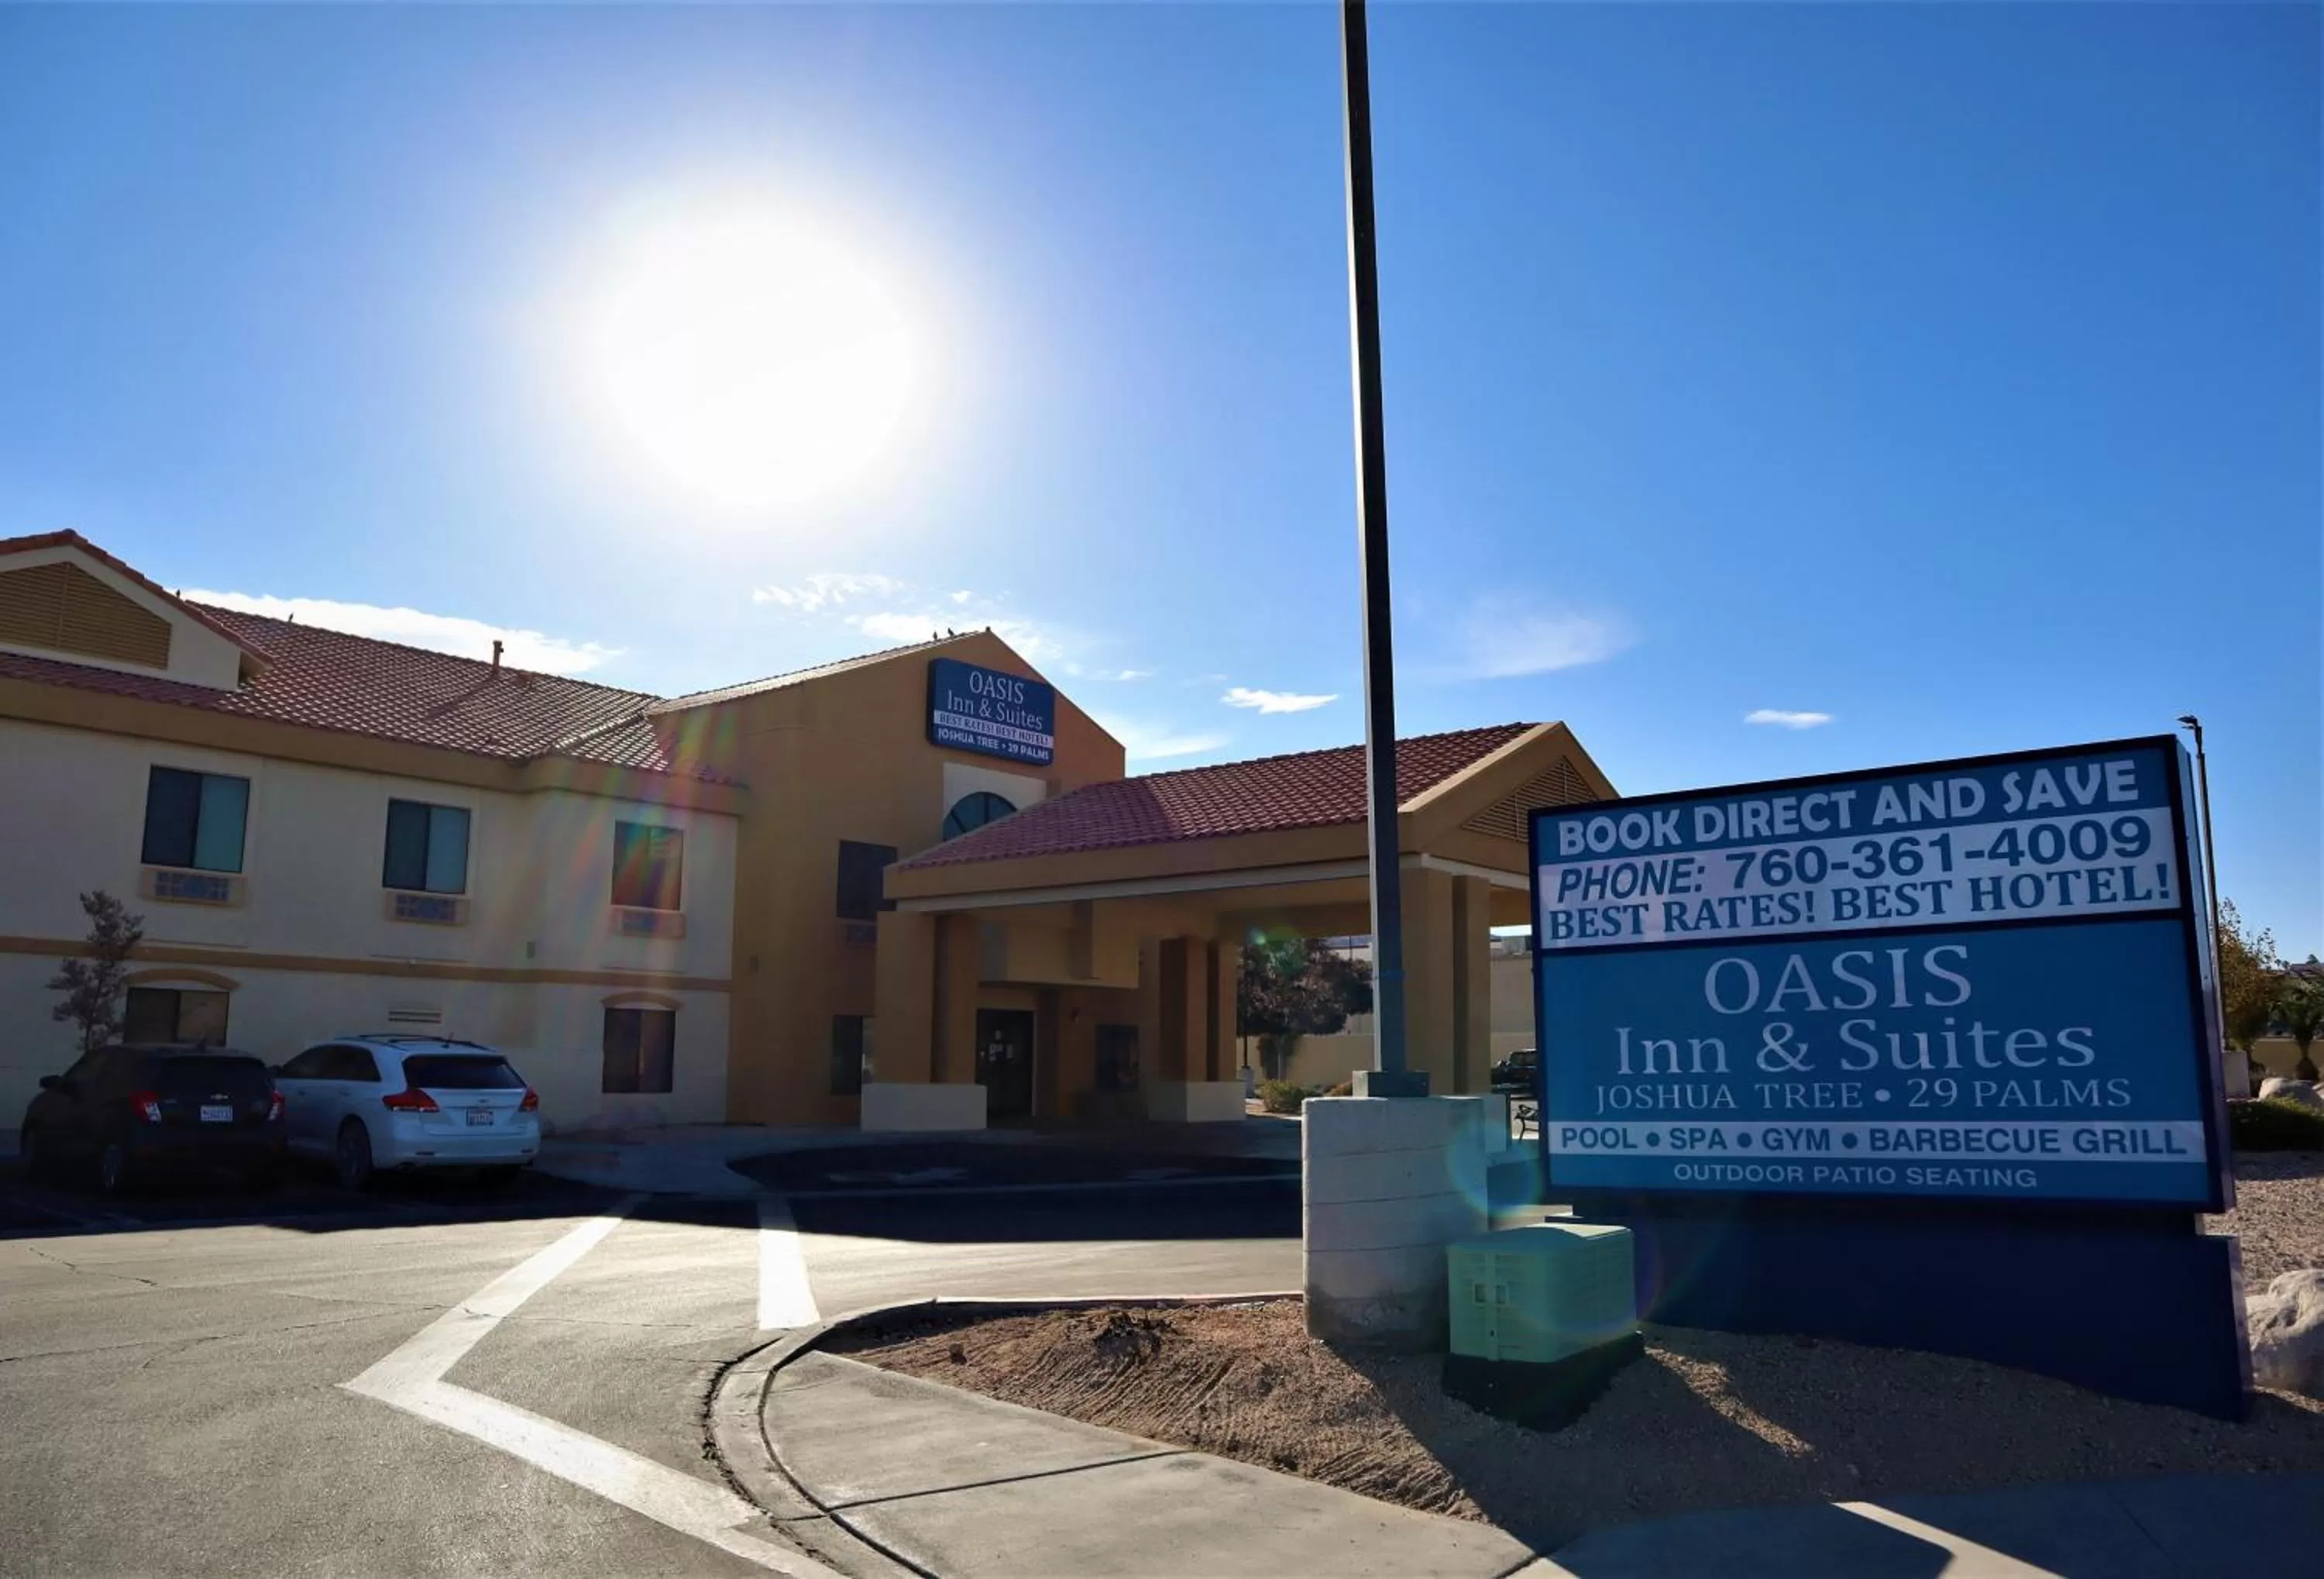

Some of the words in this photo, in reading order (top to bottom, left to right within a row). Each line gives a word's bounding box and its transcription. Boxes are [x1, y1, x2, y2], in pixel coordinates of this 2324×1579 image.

[969, 671, 1025, 704] OASIS
[947, 690, 975, 714] Inn
[978, 698, 992, 718] &
[996, 703, 1043, 730] Suites
[938, 728, 975, 745] JOSHUA
[977, 736, 999, 749] TREE
[1020, 746, 1049, 760] PALMS
[1559, 814, 1683, 857] BOOK
[1695, 790, 1857, 843] DIRECT
[1872, 777, 1985, 824] AND
[2001, 760, 2139, 814] SAVE
[1557, 856, 1705, 903] PHONE:
[1725, 815, 2152, 890] 760-361-4009
[1549, 901, 1650, 940] BEST
[1663, 890, 1816, 931] RATES!
[1832, 879, 1954, 922] BEST
[1969, 862, 2170, 913] HOTEL!
[1704, 944, 1973, 1015] OASIS
[1617, 1027, 1731, 1076] Inn
[1755, 1021, 1815, 1072] &
[1840, 1015, 2095, 1072] Suites
[1596, 1085, 1737, 1116] JOSHUA
[1753, 1082, 1863, 1110] TREE
[1907, 1078, 1958, 1109] 29
[1973, 1078, 2132, 1108] PALMS
[1561, 1127, 1638, 1152] POOL
[1669, 1127, 1728, 1152] SPA
[1761, 1127, 1831, 1152] GYM
[1868, 1127, 2061, 1154] BARBECUE
[2073, 1127, 2186, 1155] GRILL
[1673, 1163, 1803, 1183] OUTDOOR
[1813, 1166, 1896, 1185] PATIO
[1906, 1168, 2037, 1188] SEATING
